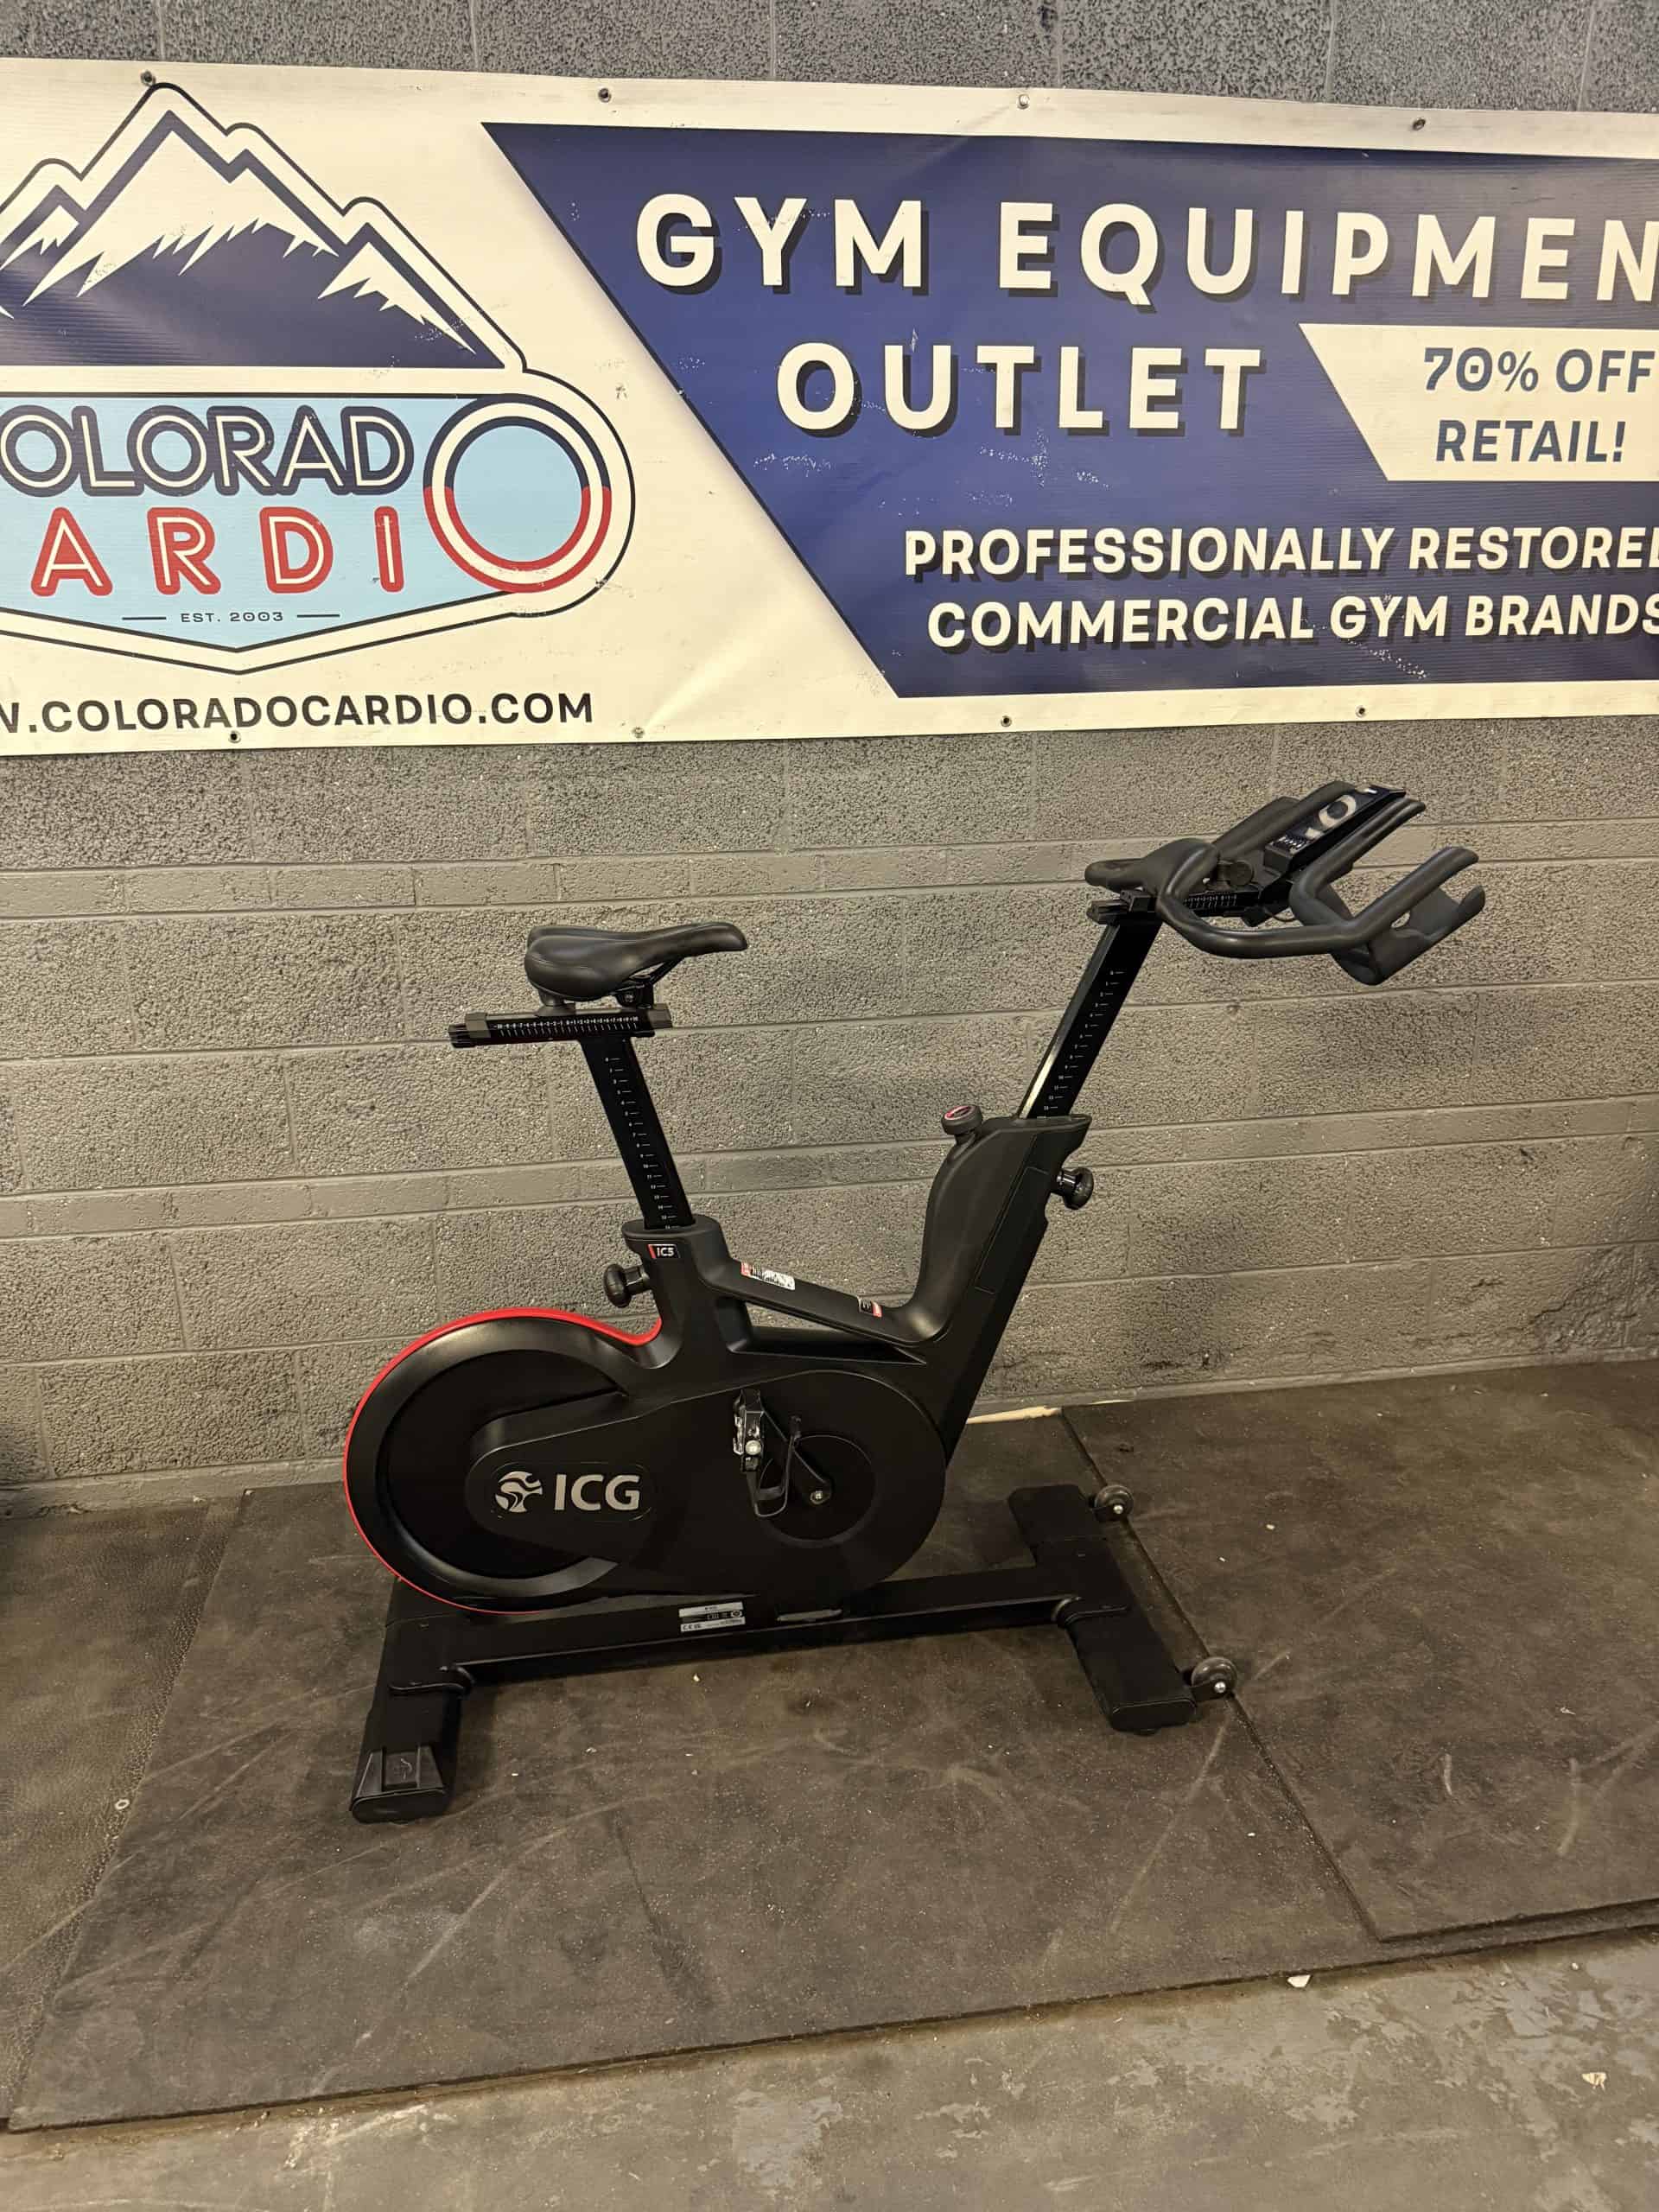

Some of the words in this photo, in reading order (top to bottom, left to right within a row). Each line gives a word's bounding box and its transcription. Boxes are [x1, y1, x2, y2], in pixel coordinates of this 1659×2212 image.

[636, 193, 922, 287] GYM
[777, 342, 1262, 430] OUTLET
[1424, 346, 1539, 392] 70%
[1556, 348, 1656, 392] OFF
[1436, 420, 1626, 462] RETAIL!
[906, 527, 1395, 576] PROFESSIONALLY
[1409, 525, 1659, 570] RESTORE
[181, 613, 222, 623] EST.
[229, 611, 284, 622] 2003
[928, 595, 1314, 648] COMMERCIAL
[1330, 594, 1448, 639] GYM
[1465, 592, 1659, 637] BRANDS
[553, 1473, 641, 1511] ICG
